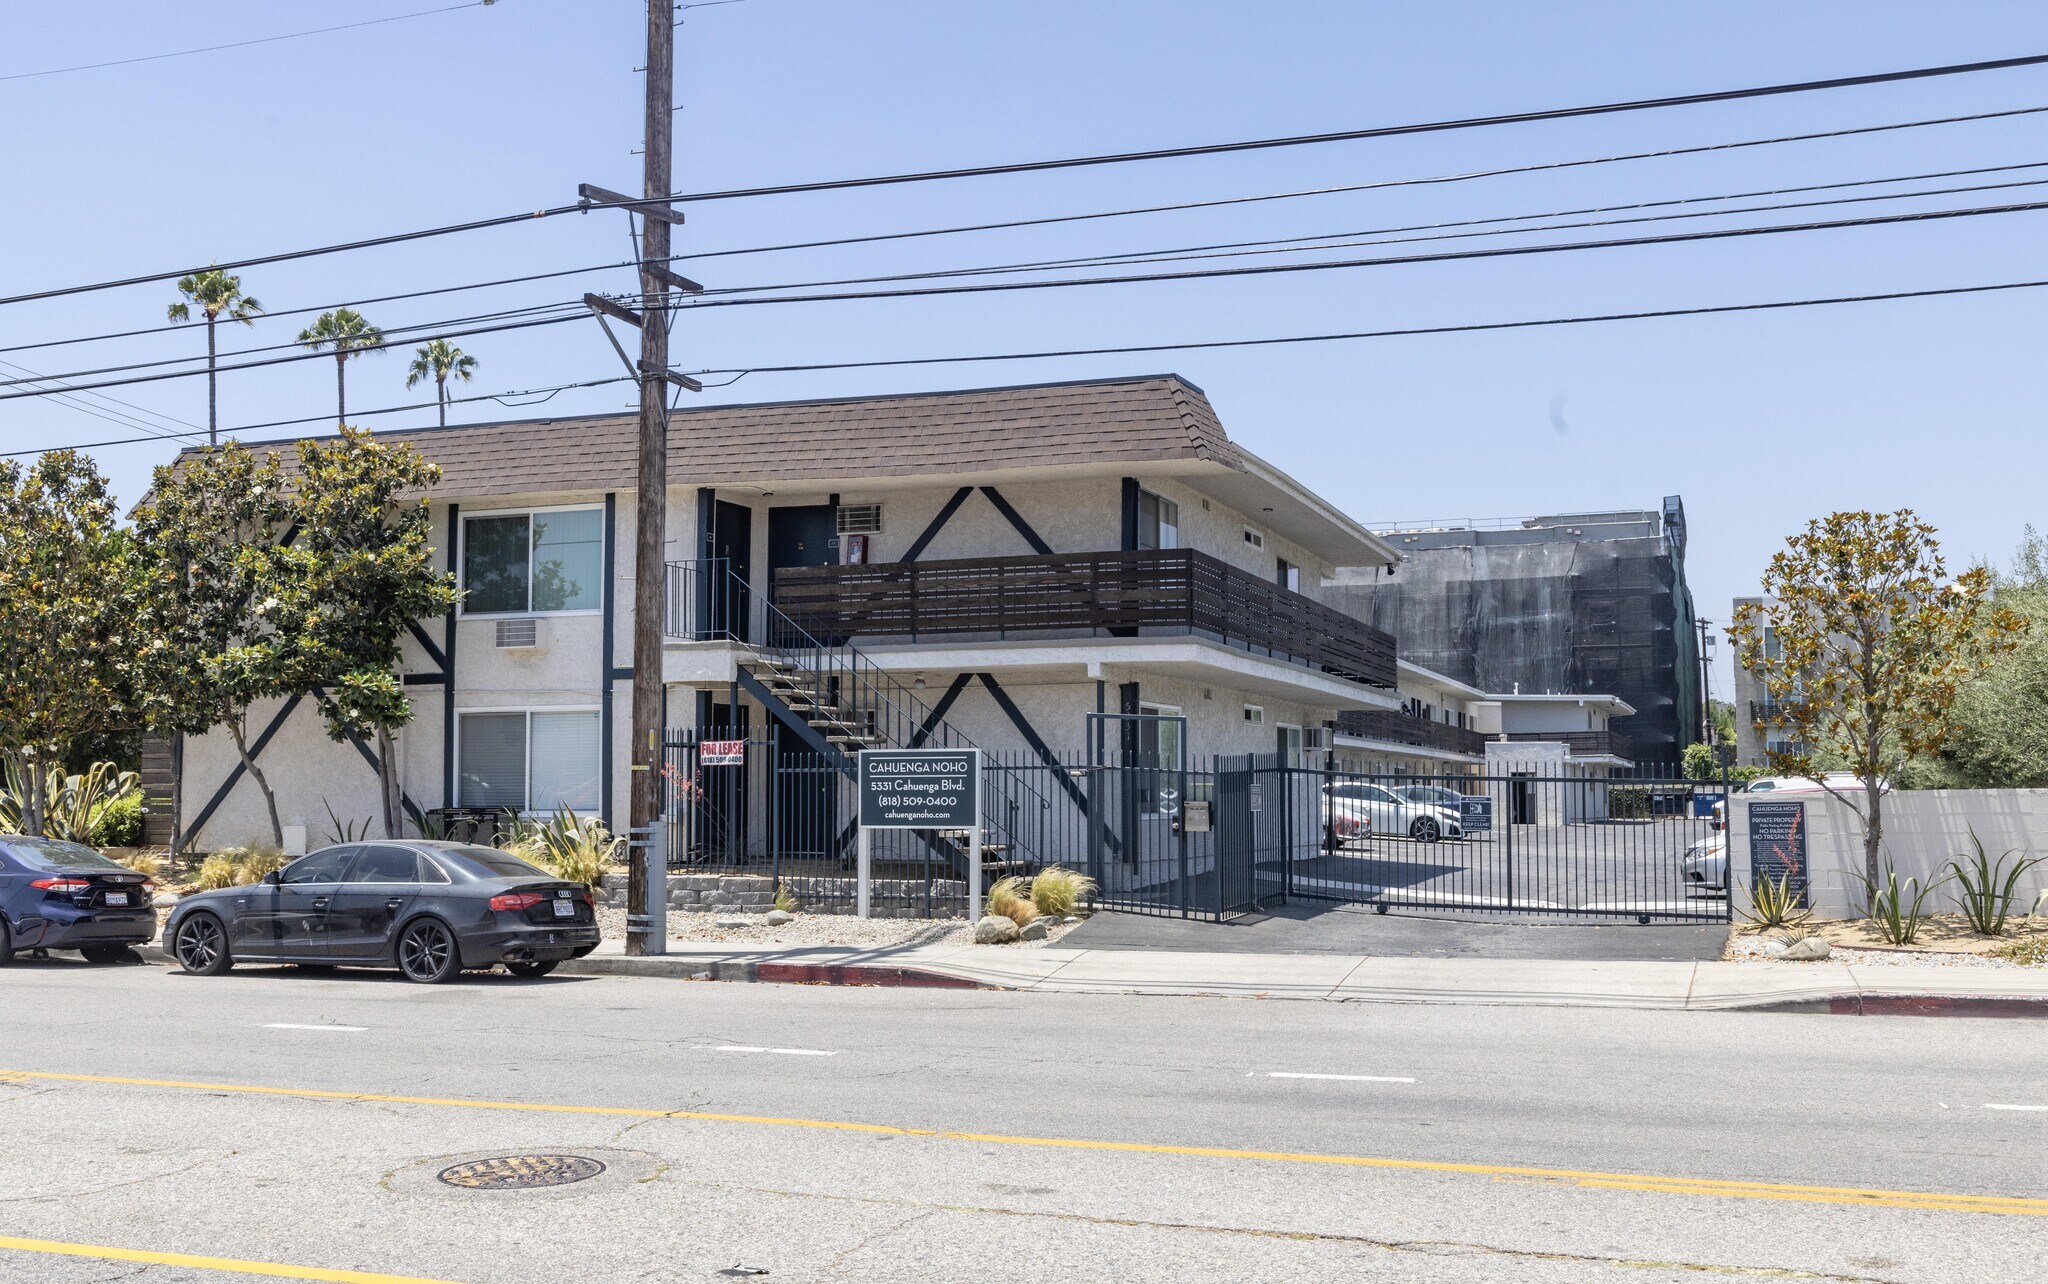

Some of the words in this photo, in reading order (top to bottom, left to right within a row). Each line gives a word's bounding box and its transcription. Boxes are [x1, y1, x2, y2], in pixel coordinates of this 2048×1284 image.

[701, 743, 716, 755] FOR
[718, 742, 743, 754] LEASE
[869, 762, 930, 773] CAHUENGA
[932, 761, 968, 772] NOHO
[870, 782, 892, 791] 5331
[894, 780, 939, 793] Cahuenga
[941, 779, 965, 791] Blvd.
[878, 795, 901, 807] (818)
[902, 796, 957, 806] 509-0400
[885, 809, 950, 820] cahuenganoho.com
